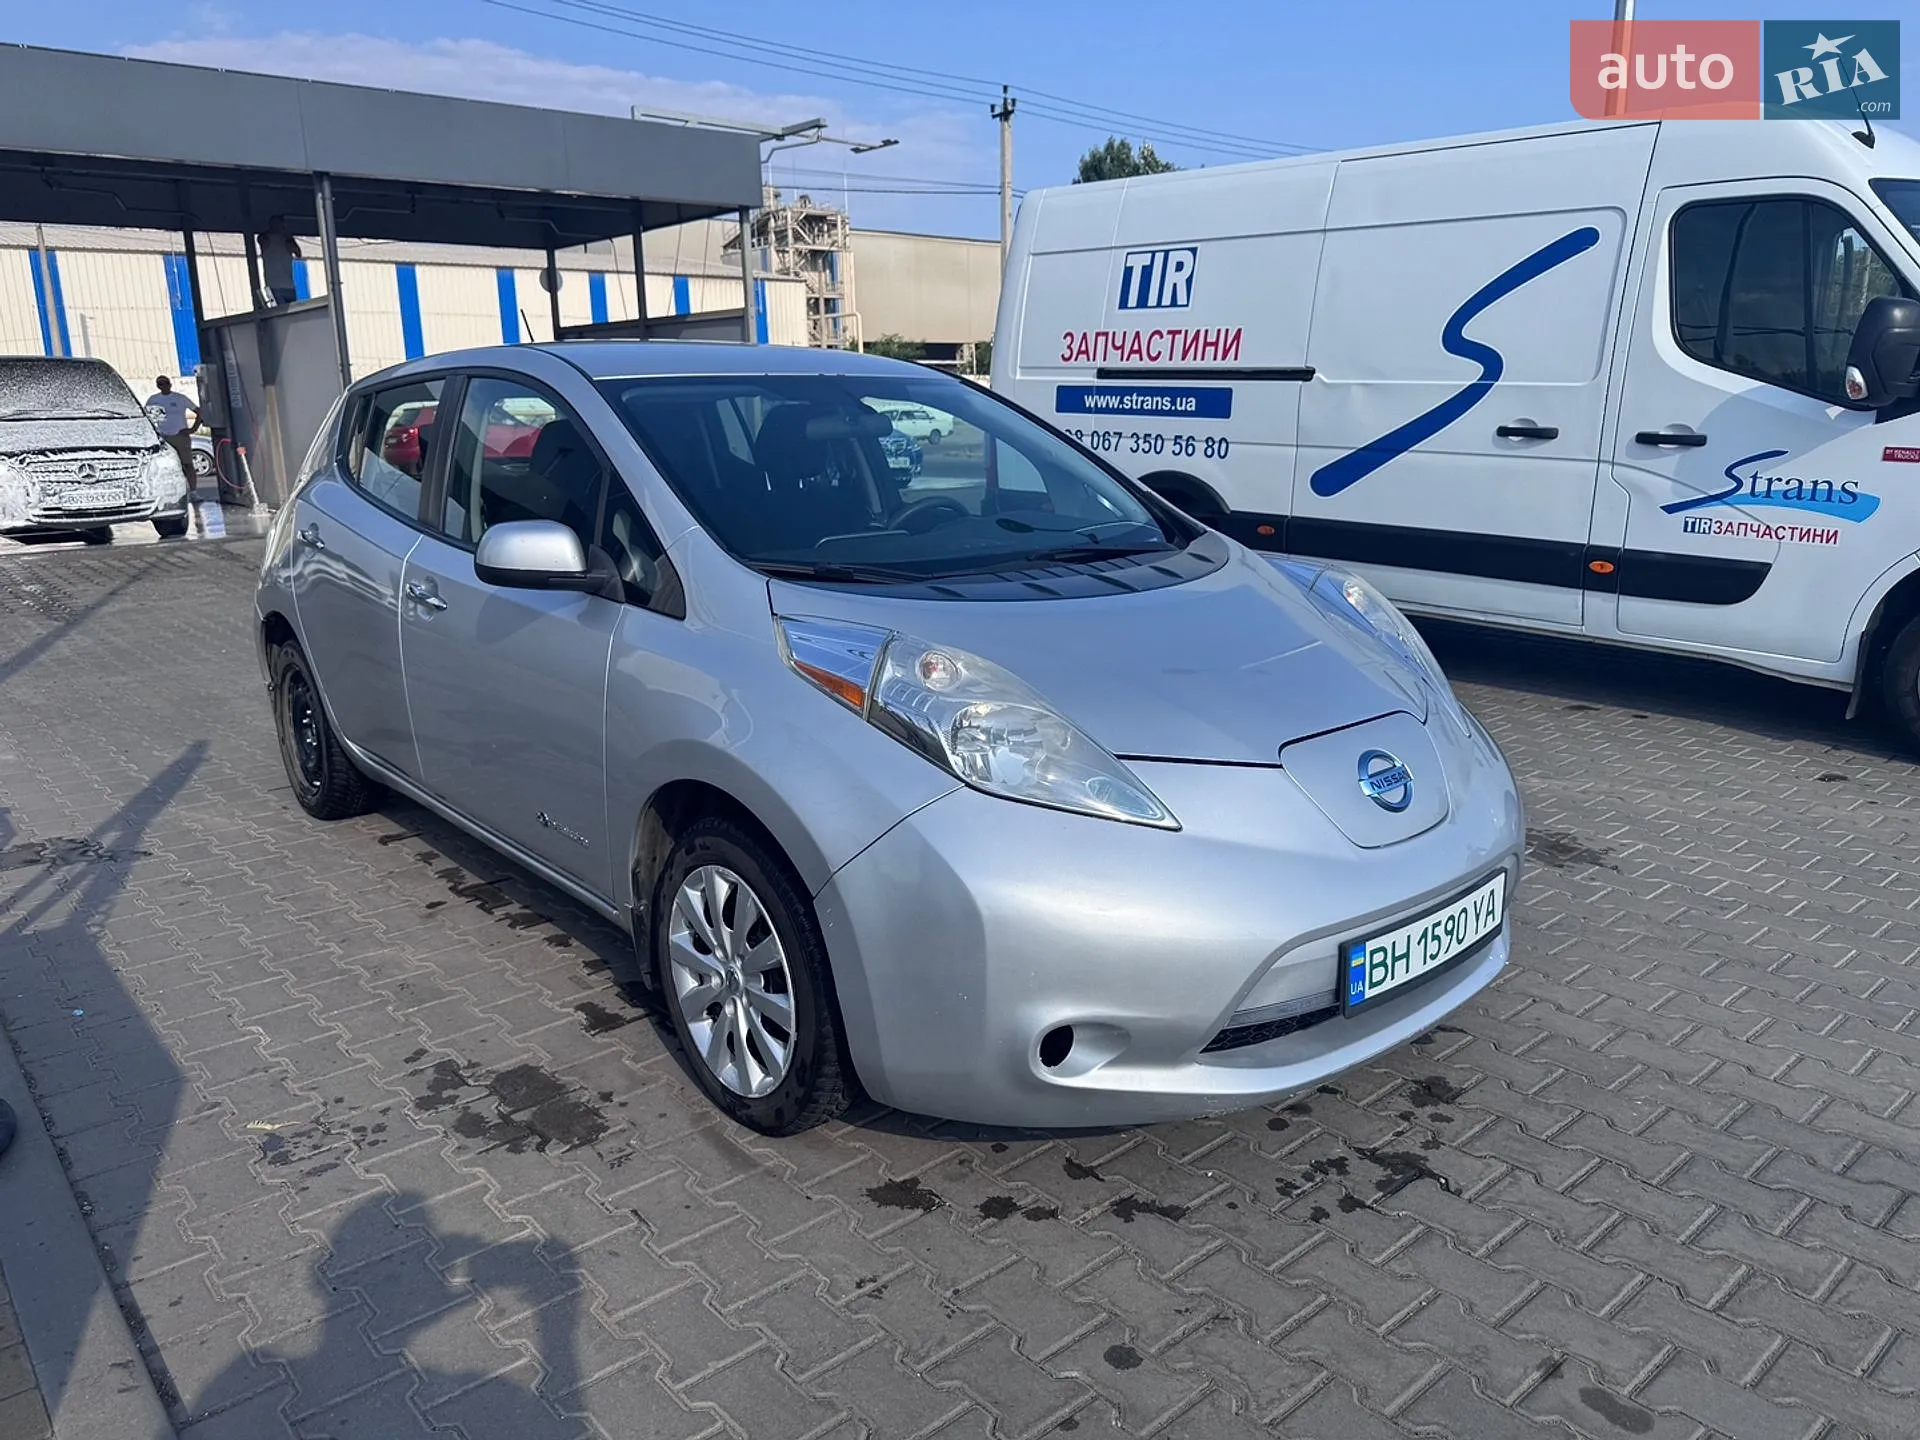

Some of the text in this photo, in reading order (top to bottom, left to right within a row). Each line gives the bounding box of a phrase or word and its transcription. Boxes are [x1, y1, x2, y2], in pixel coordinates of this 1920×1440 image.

[1125, 249, 1195, 308] TIR
[1060, 327, 1243, 363] ЗАПЧАСТИНИ
[1084, 392, 1196, 411] www.strans.ua
[1090, 430, 1122, 452] 067
[1129, 432, 1165, 456] 350
[1171, 434, 1196, 457] 56
[1203, 436, 1230, 460] 80
[1659, 450, 1859, 514] Strans
[1368, 887, 1496, 990] BH 1590 YA
[1350, 983, 1364, 995] UA
